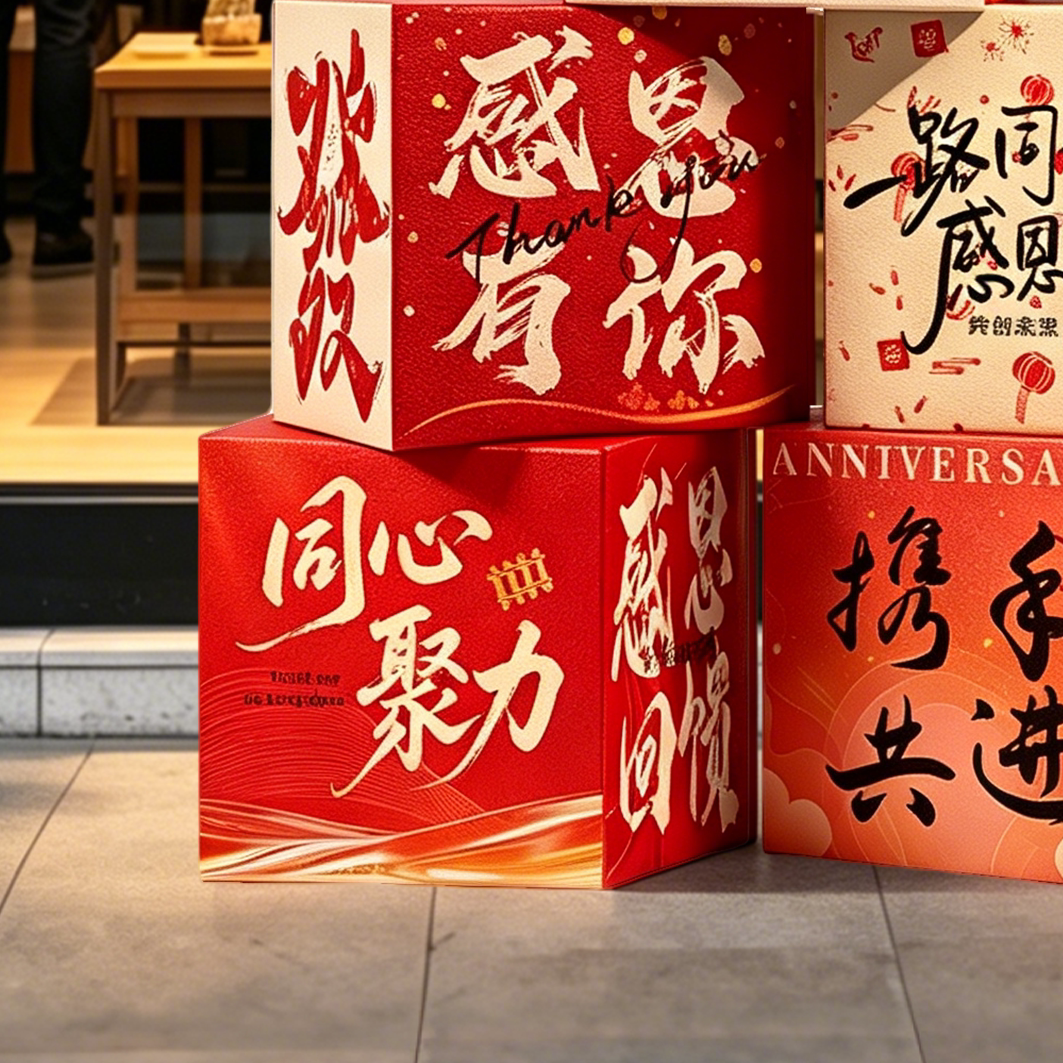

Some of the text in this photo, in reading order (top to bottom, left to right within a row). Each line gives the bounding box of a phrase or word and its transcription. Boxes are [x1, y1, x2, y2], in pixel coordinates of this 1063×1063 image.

[428, 25, 760, 220] 感恩
[446, 132, 768, 284] Thank you
[431, 224, 766, 396] 有你
[234, 474, 493, 653] 同心
[611, 465, 733, 683] 感恩
[330, 603, 566, 798] 聚力
